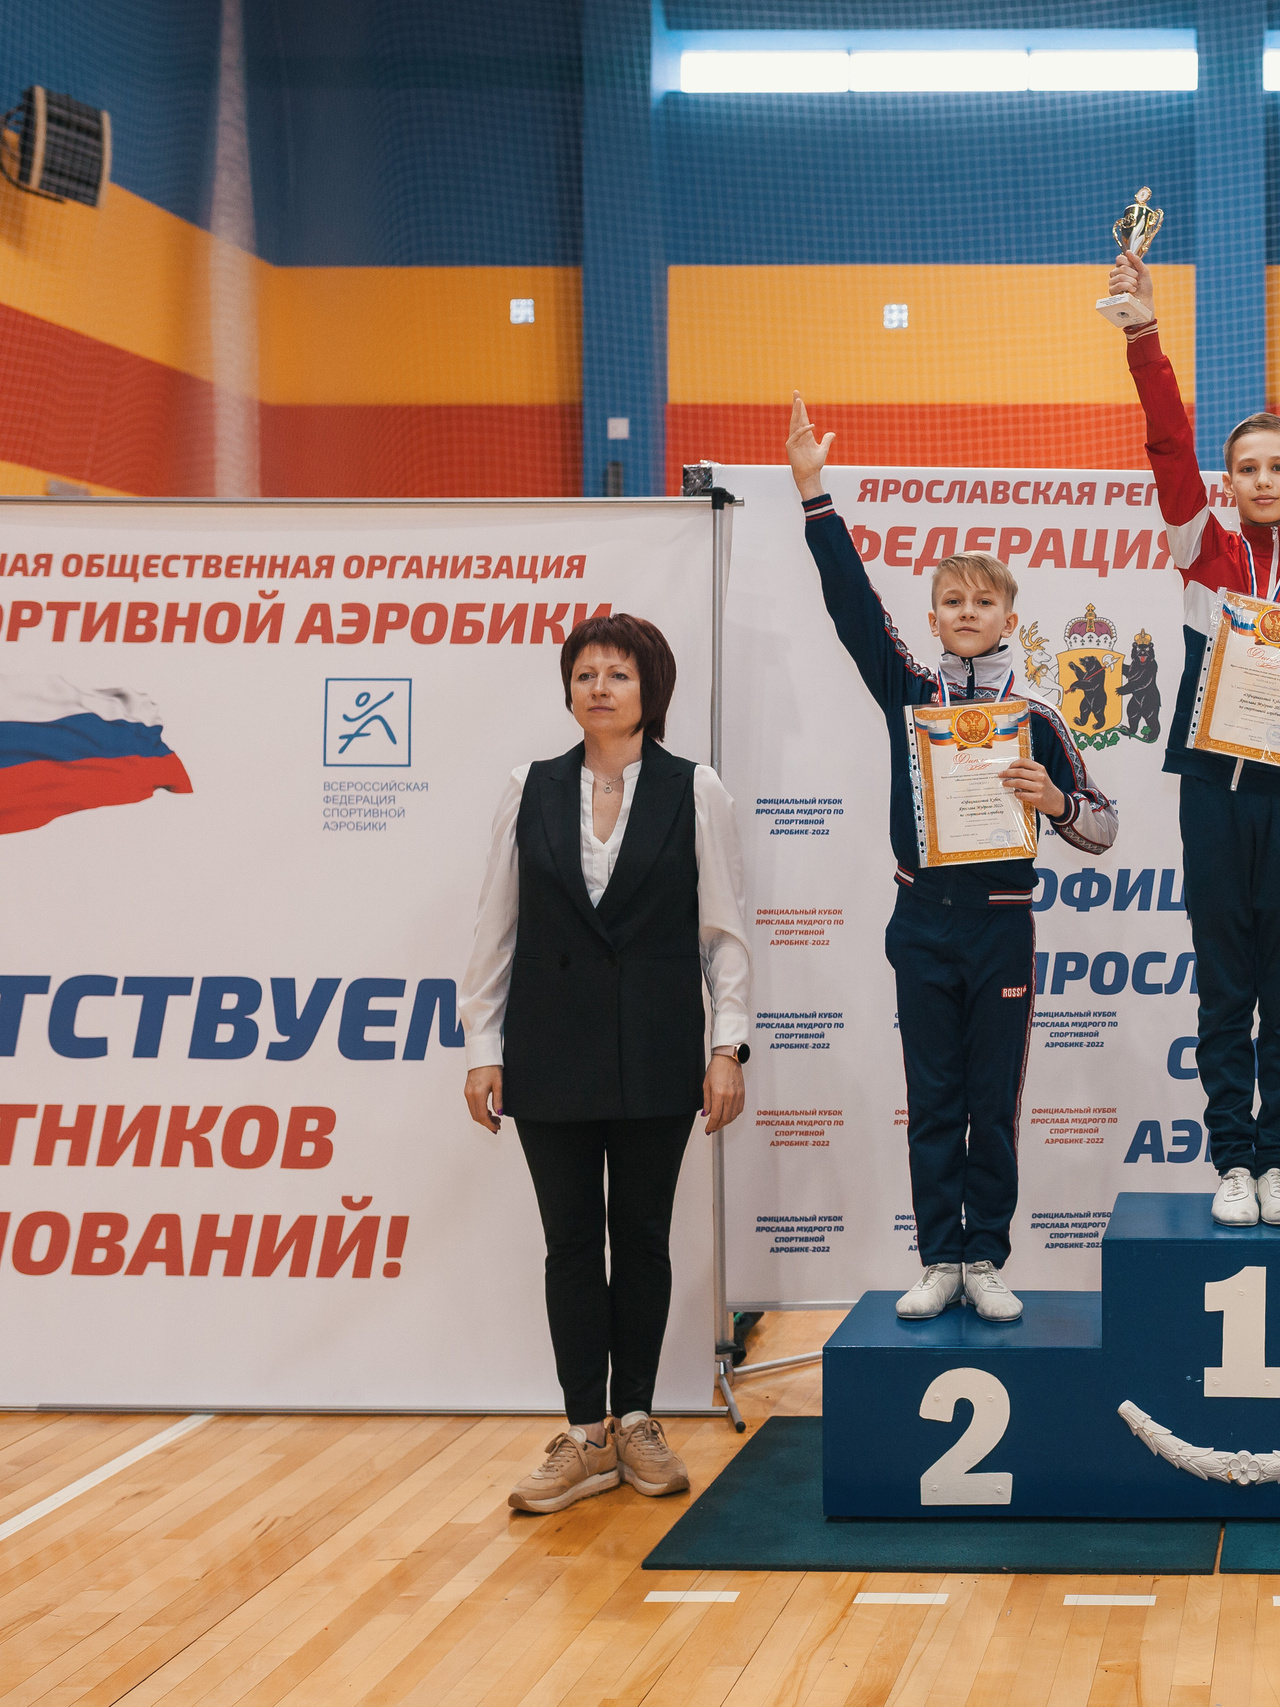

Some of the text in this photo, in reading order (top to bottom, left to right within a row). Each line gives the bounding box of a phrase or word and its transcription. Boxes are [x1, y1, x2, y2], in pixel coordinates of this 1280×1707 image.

[857, 479, 1098, 506] ЯРОСЛАВСКАЯ
[61, 553, 334, 584] ОБЩЕСТВЕННАЯ
[342, 554, 586, 584] ОРГАНИЗАЦИЯ
[0, 590, 284, 646] РТИВНОЙ
[323, 780, 430, 792] ВСЕРОССИЙСКАЯ
[323, 795, 396, 806] ФЕДЕРАЦИЯ
[756, 797, 817, 805] ОФИЦИАЛЬНЫЙ
[323, 807, 406, 818] СПОРТИВНОЙ
[796, 808, 832, 816] МУДРОГО
[322, 821, 387, 832] АЭРОБИКИ
[756, 908, 843, 916] ОФИЦИАЛЬНЫЙ КУБОК
[755, 918, 844, 926] ЯРОСЛАВА МУДРОГО ПО
[774, 928, 825, 936] СПОРТИВНОЙ
[756, 1012, 817, 1020] ОФИЦИАЛЬНЫЙ
[755, 1022, 795, 1030] ЯРОСЛАВА
[796, 1022, 832, 1030] МУДРОГО
[774, 1032, 825, 1040] СПОРТИВНОЙ
[1050, 1030, 1100, 1038] СПОРТИВНОЙ
[770, 1042, 830, 1050] АЭРОБИКЕ-2022
[756, 1108, 817, 1117] ОФИЦИАЛЬНЫЙ
[1031, 1106, 1091, 1115] ОФИЦИАЛЬНЫЙ
[755, 1119, 795, 1127] ЯРОСЛАВА
[796, 1119, 832, 1128] МУДРОГО
[0, 1104, 338, 1170] ТНИКОВ
[774, 1129, 825, 1138] СПОРТИВНОЙ
[756, 1214, 817, 1223] ОФИЦИАЛЬНЫЙ
[1031, 1211, 1091, 1220] ОФИЦИАЛЬНЫЙ
[0, 1196, 410, 1278] ОВАНИЙ!
[774, 1235, 825, 1243] СПОРТИВНОЙ
[1049, 1230, 1099, 1239] СПОРТИВНОЙ
[918, 1367, 1014, 1506] 2
